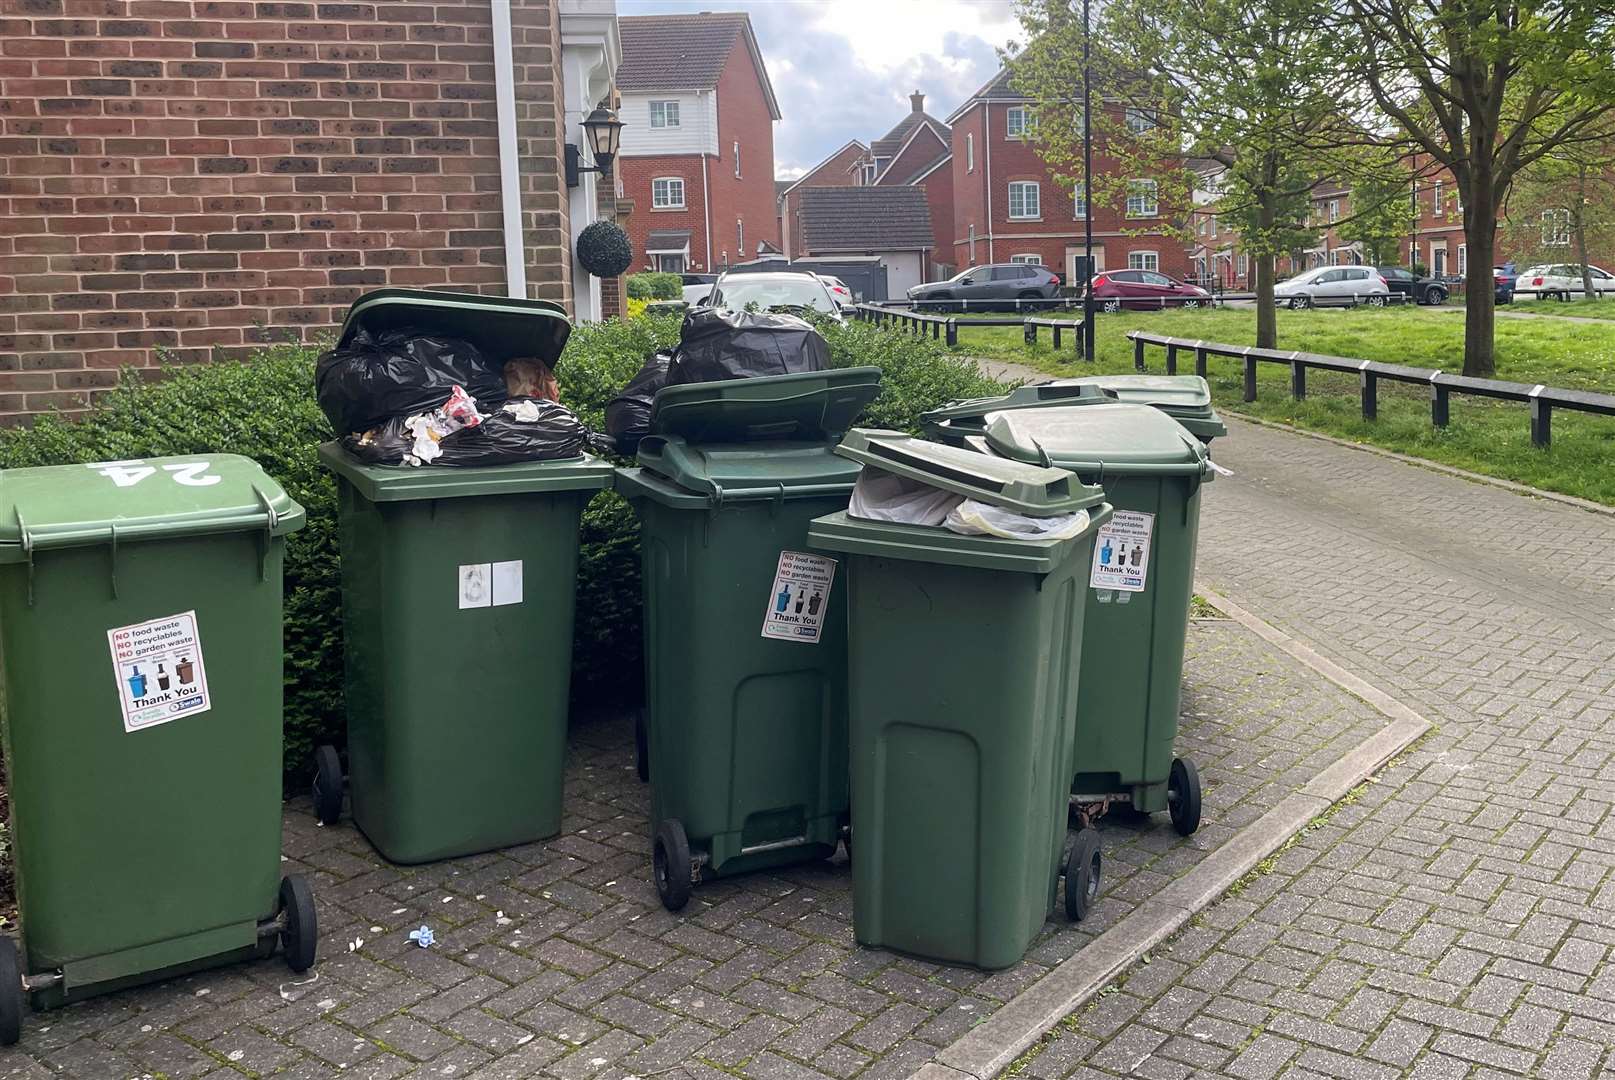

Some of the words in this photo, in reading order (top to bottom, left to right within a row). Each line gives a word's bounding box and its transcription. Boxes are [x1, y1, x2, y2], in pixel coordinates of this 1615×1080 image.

[98, 462, 222, 487] 24
[1100, 565, 1123, 573] Thank
[1126, 567, 1139, 575] You
[774, 613, 799, 623] Thank
[803, 616, 816, 624] You
[116, 632, 129, 640] NO
[133, 628, 152, 637] food
[154, 621, 180, 631] waste
[134, 630, 182, 646] recyclables
[136, 643, 165, 656] garden
[168, 637, 192, 647] waste
[133, 692, 171, 708] Thank
[175, 686, 197, 697] You
